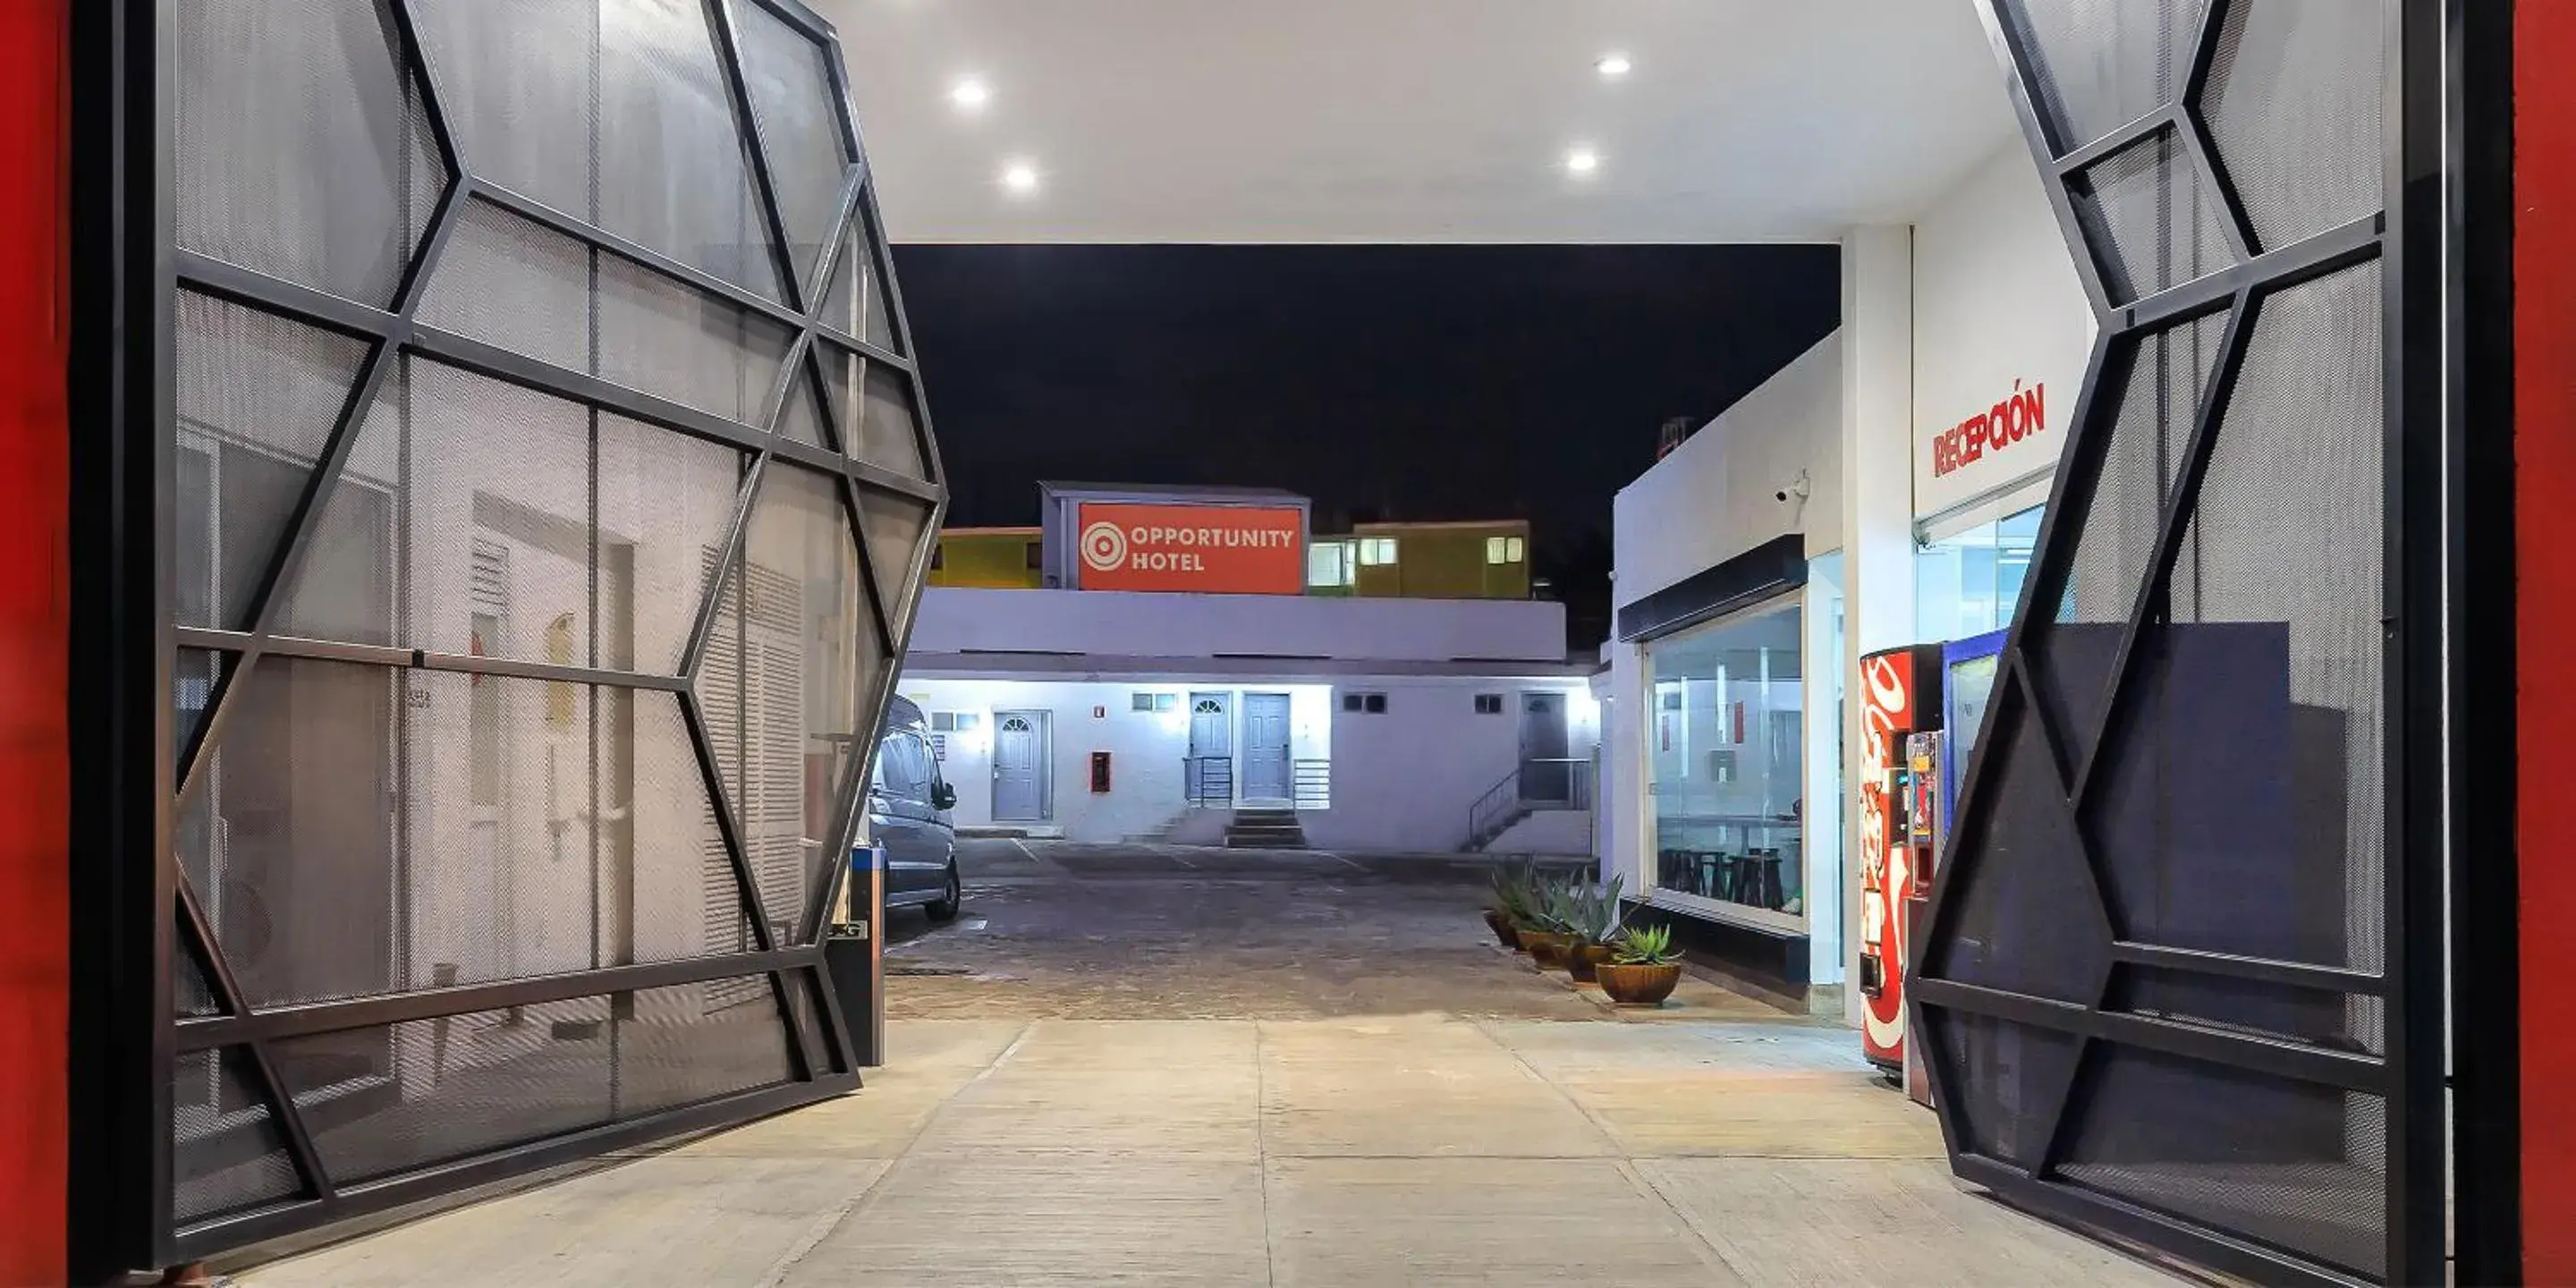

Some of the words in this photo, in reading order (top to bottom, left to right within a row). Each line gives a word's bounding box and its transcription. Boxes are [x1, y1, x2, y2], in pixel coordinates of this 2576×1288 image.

[1932, 378, 2045, 478] RECEPCIÓN
[1131, 526, 1294, 548] OPPORTUNITY
[1131, 551, 1205, 572] HOTEL
